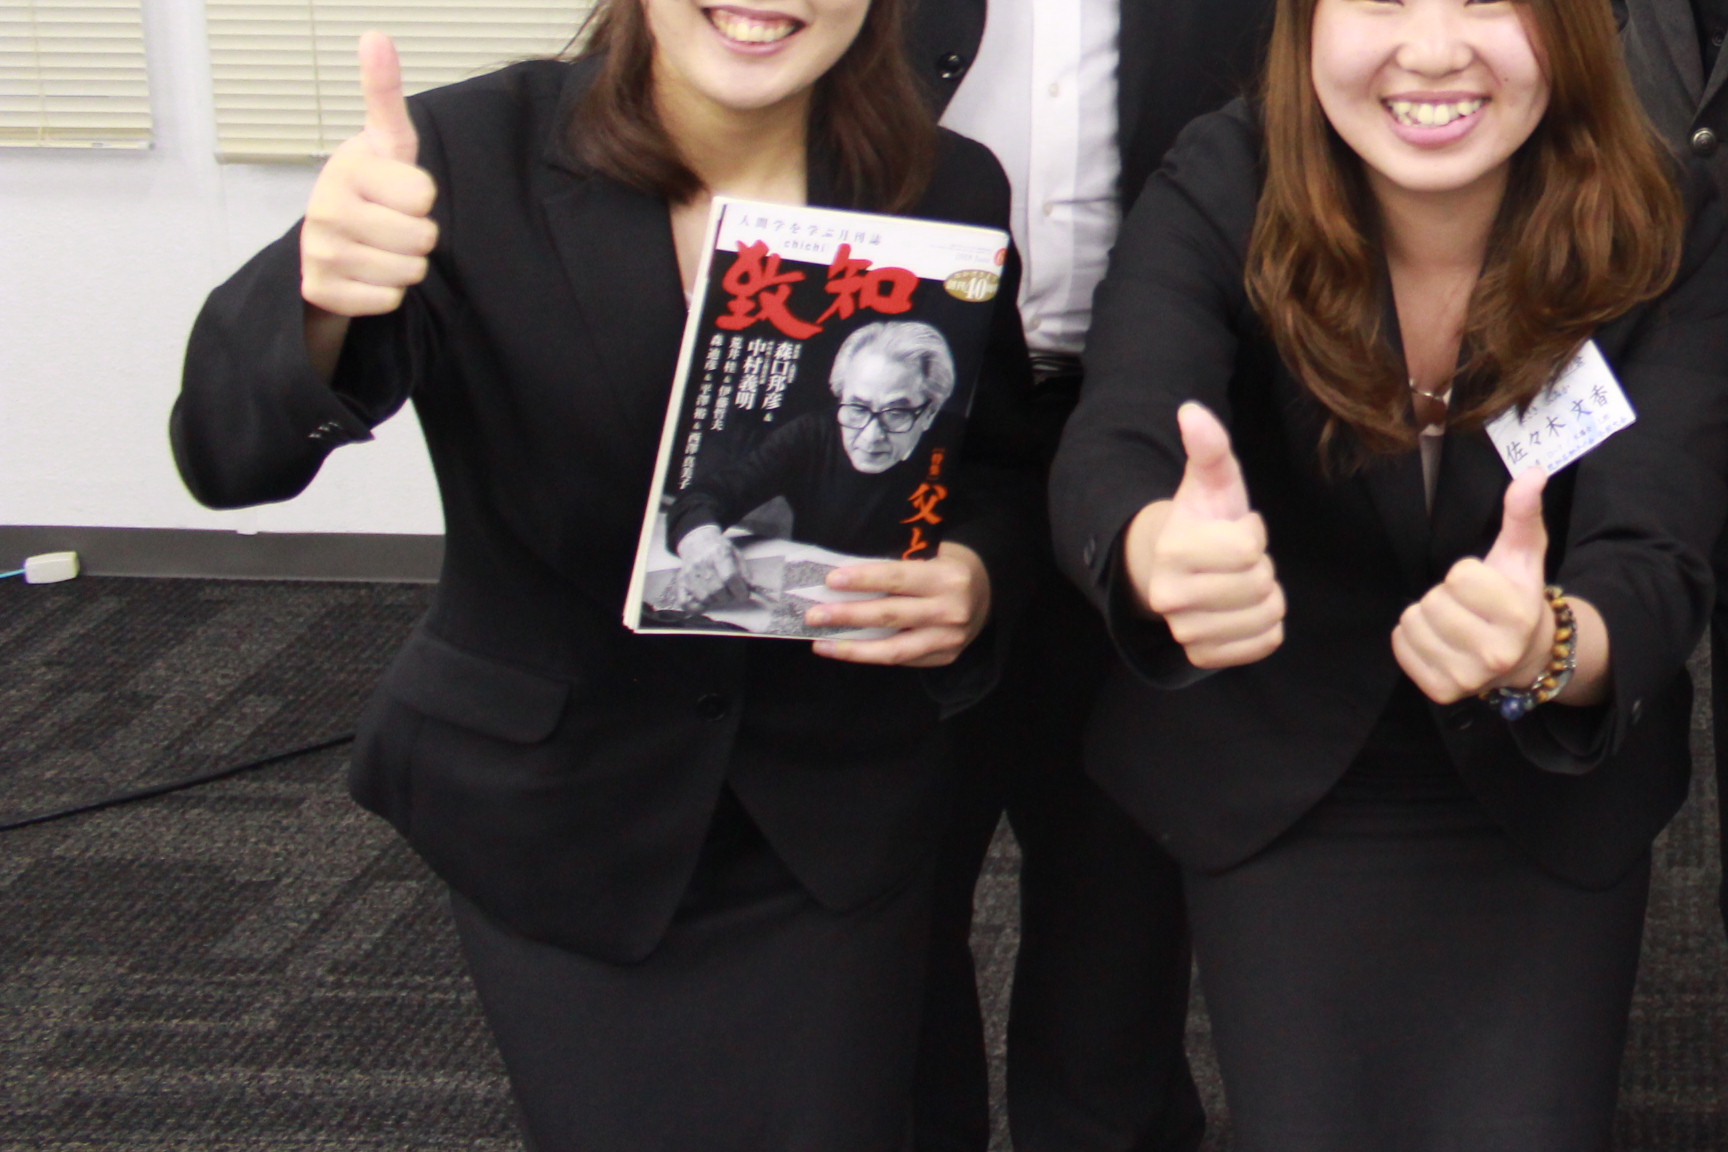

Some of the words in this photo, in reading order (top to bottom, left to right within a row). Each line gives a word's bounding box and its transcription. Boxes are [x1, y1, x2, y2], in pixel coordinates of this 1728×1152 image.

[739, 214, 881, 246] 人間学を学ぶ月刊誌
[783, 238, 826, 253] chichi
[715, 239, 919, 339] 致知
[735, 337, 766, 410] 中村義明
[761, 340, 793, 410] 森口邦彦
[1505, 416, 1567, 465] 佐々木
[1570, 384, 1608, 421] 文香
[899, 482, 949, 560] 父と
